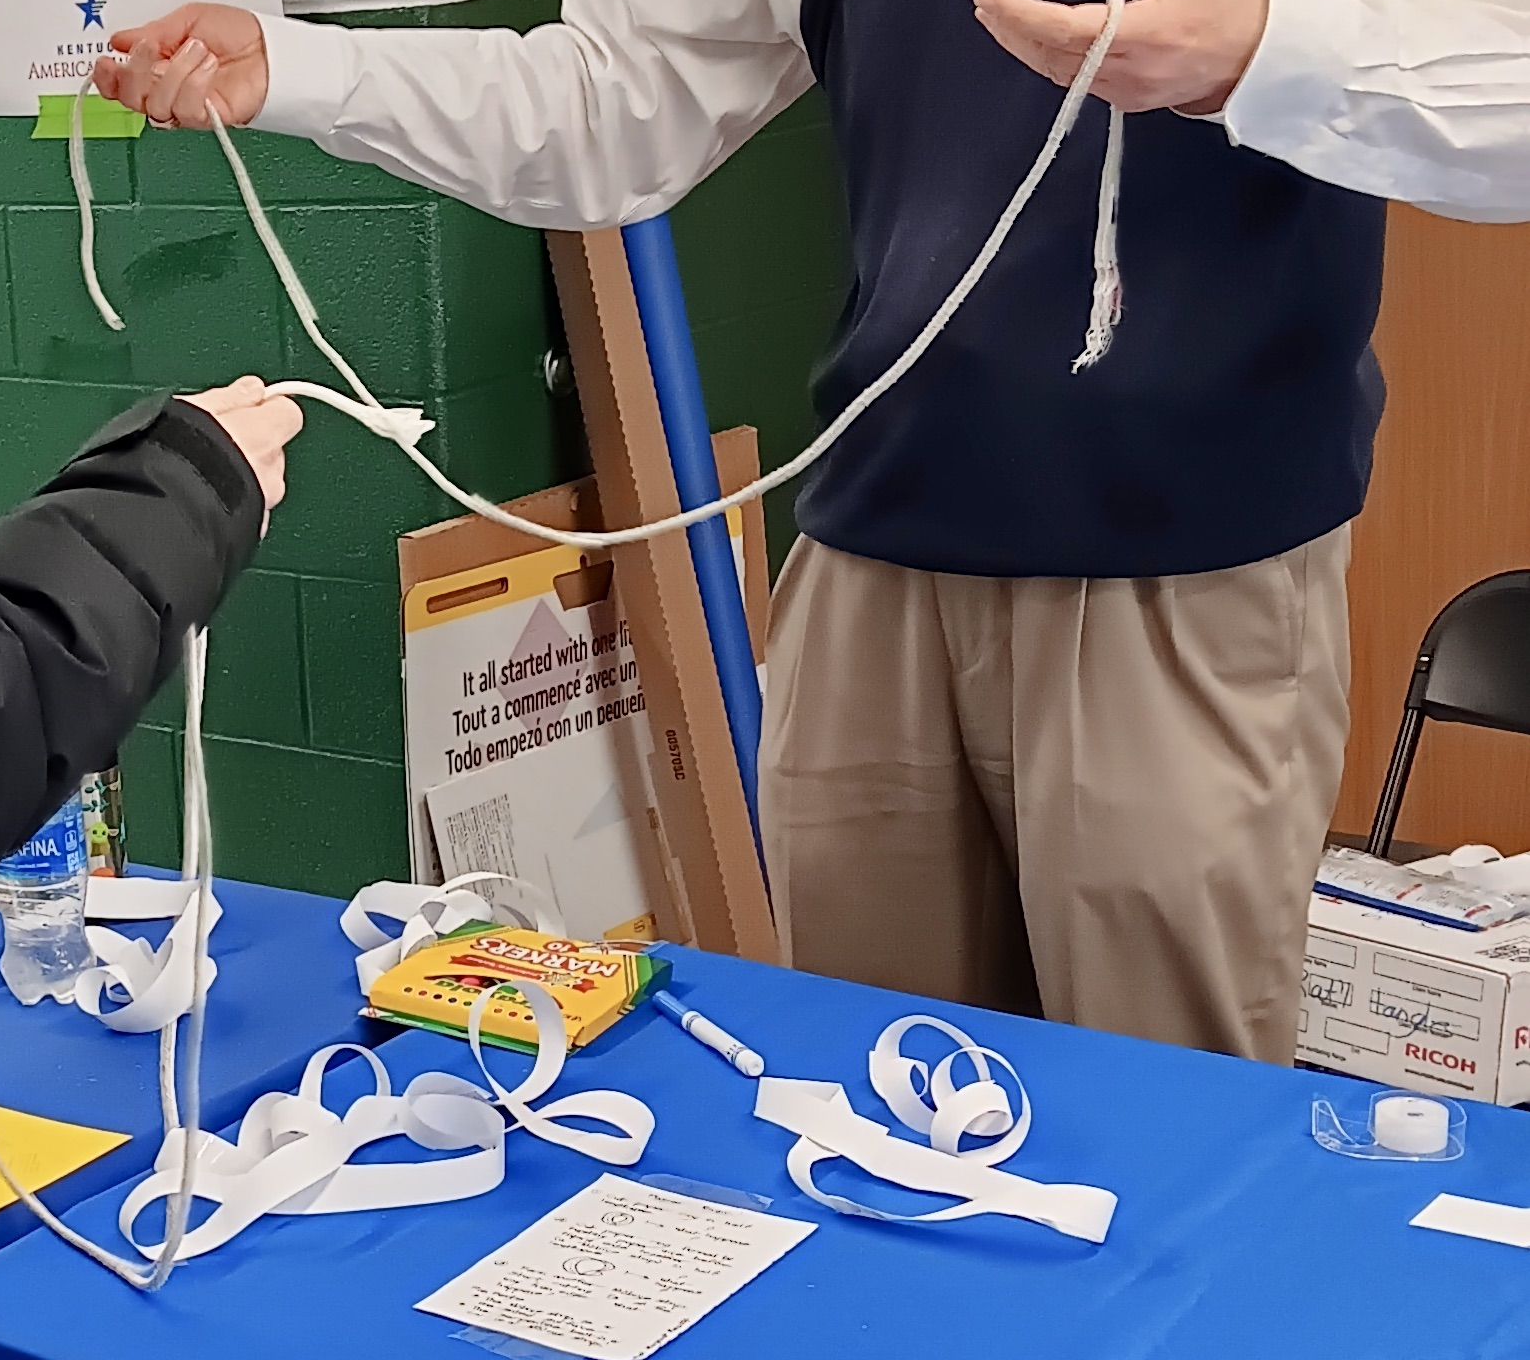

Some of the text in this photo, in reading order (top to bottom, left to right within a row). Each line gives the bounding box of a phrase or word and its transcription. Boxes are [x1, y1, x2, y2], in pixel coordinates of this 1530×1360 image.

[463, 671, 475, 697] It
[479, 660, 497, 692] all
[501, 642, 553, 686] started
[555, 634, 588, 667] with
[591, 633, 617, 657] one
[452, 660, 637, 737] Tout a commencé avec un
[445, 740, 482, 776] Todo
[486, 717, 543, 762] empezó
[546, 717, 572, 743] con
[575, 710, 593, 733] un
[474, 936, 620, 978] MARKERS
[546, 941, 570, 953] 10
[1405, 1042, 1476, 1074] RICOH
